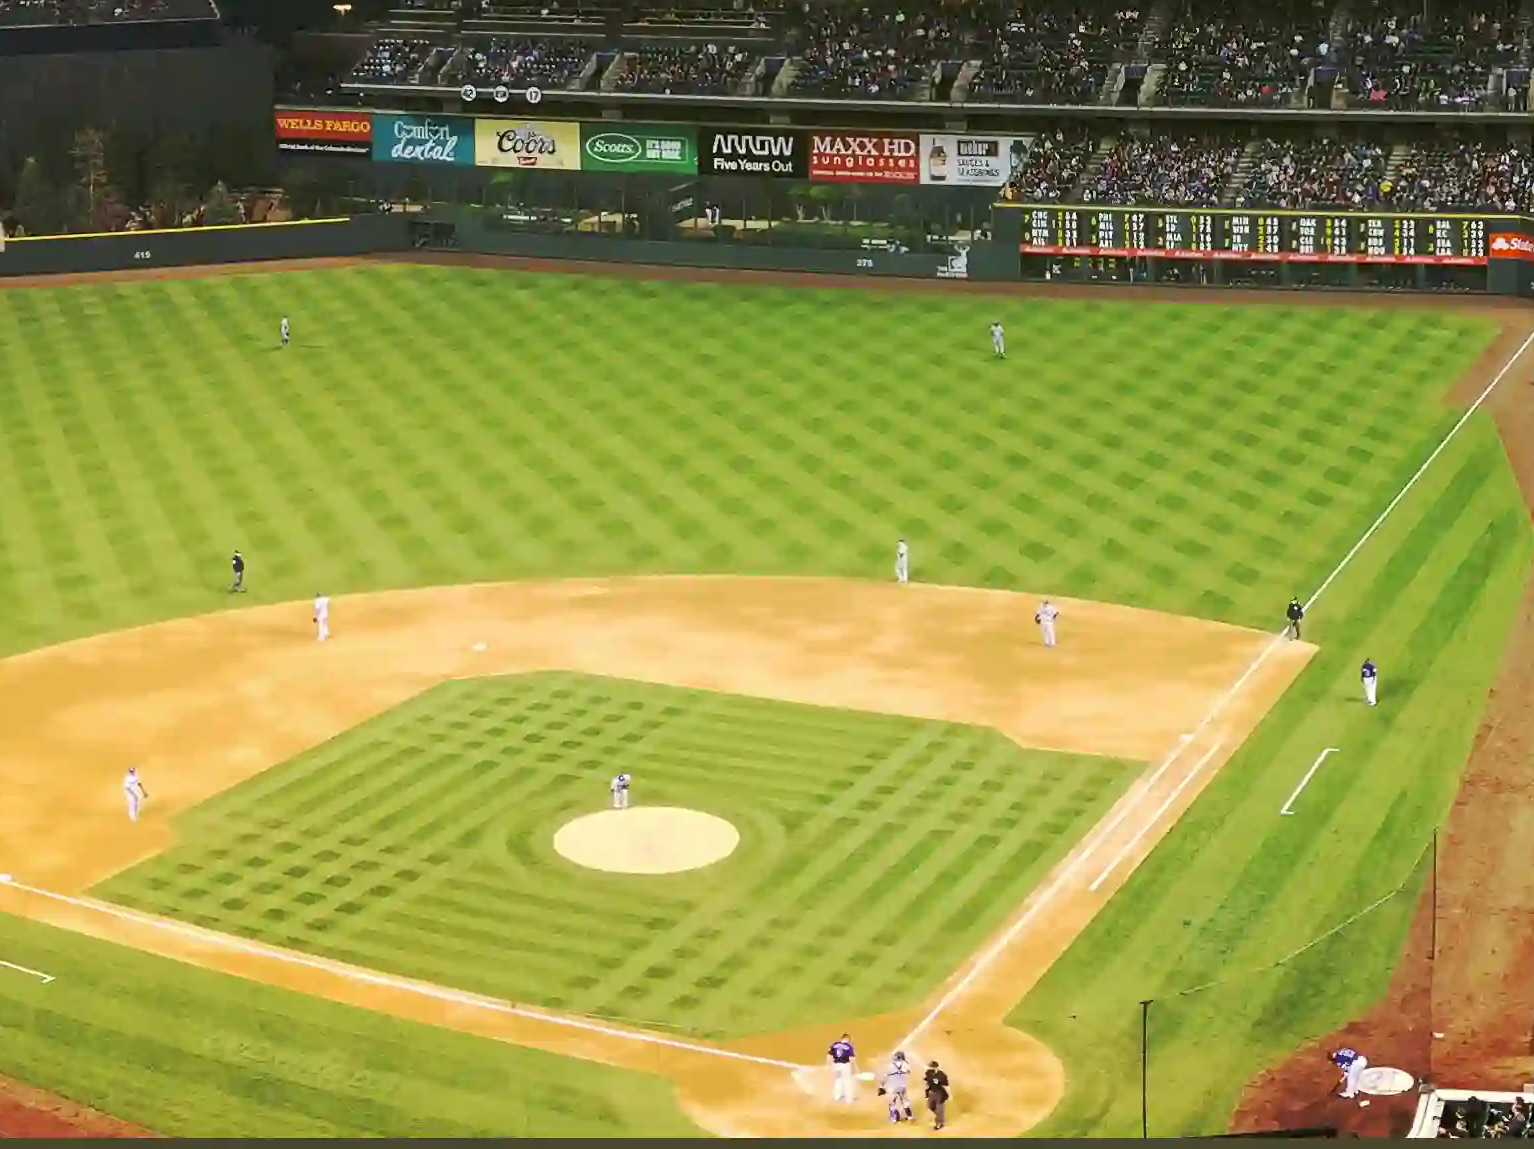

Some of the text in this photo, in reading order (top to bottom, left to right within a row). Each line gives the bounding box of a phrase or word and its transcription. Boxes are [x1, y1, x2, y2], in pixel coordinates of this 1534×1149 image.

[277, 118, 371, 133] WELLS FARGO
[391, 135, 458, 161] dental
[496, 129, 556, 154] Coors
[812, 136, 916, 157] MAXX HD
[713, 157, 793, 173] Five Years Out
[812, 155, 916, 169] sunglasses
